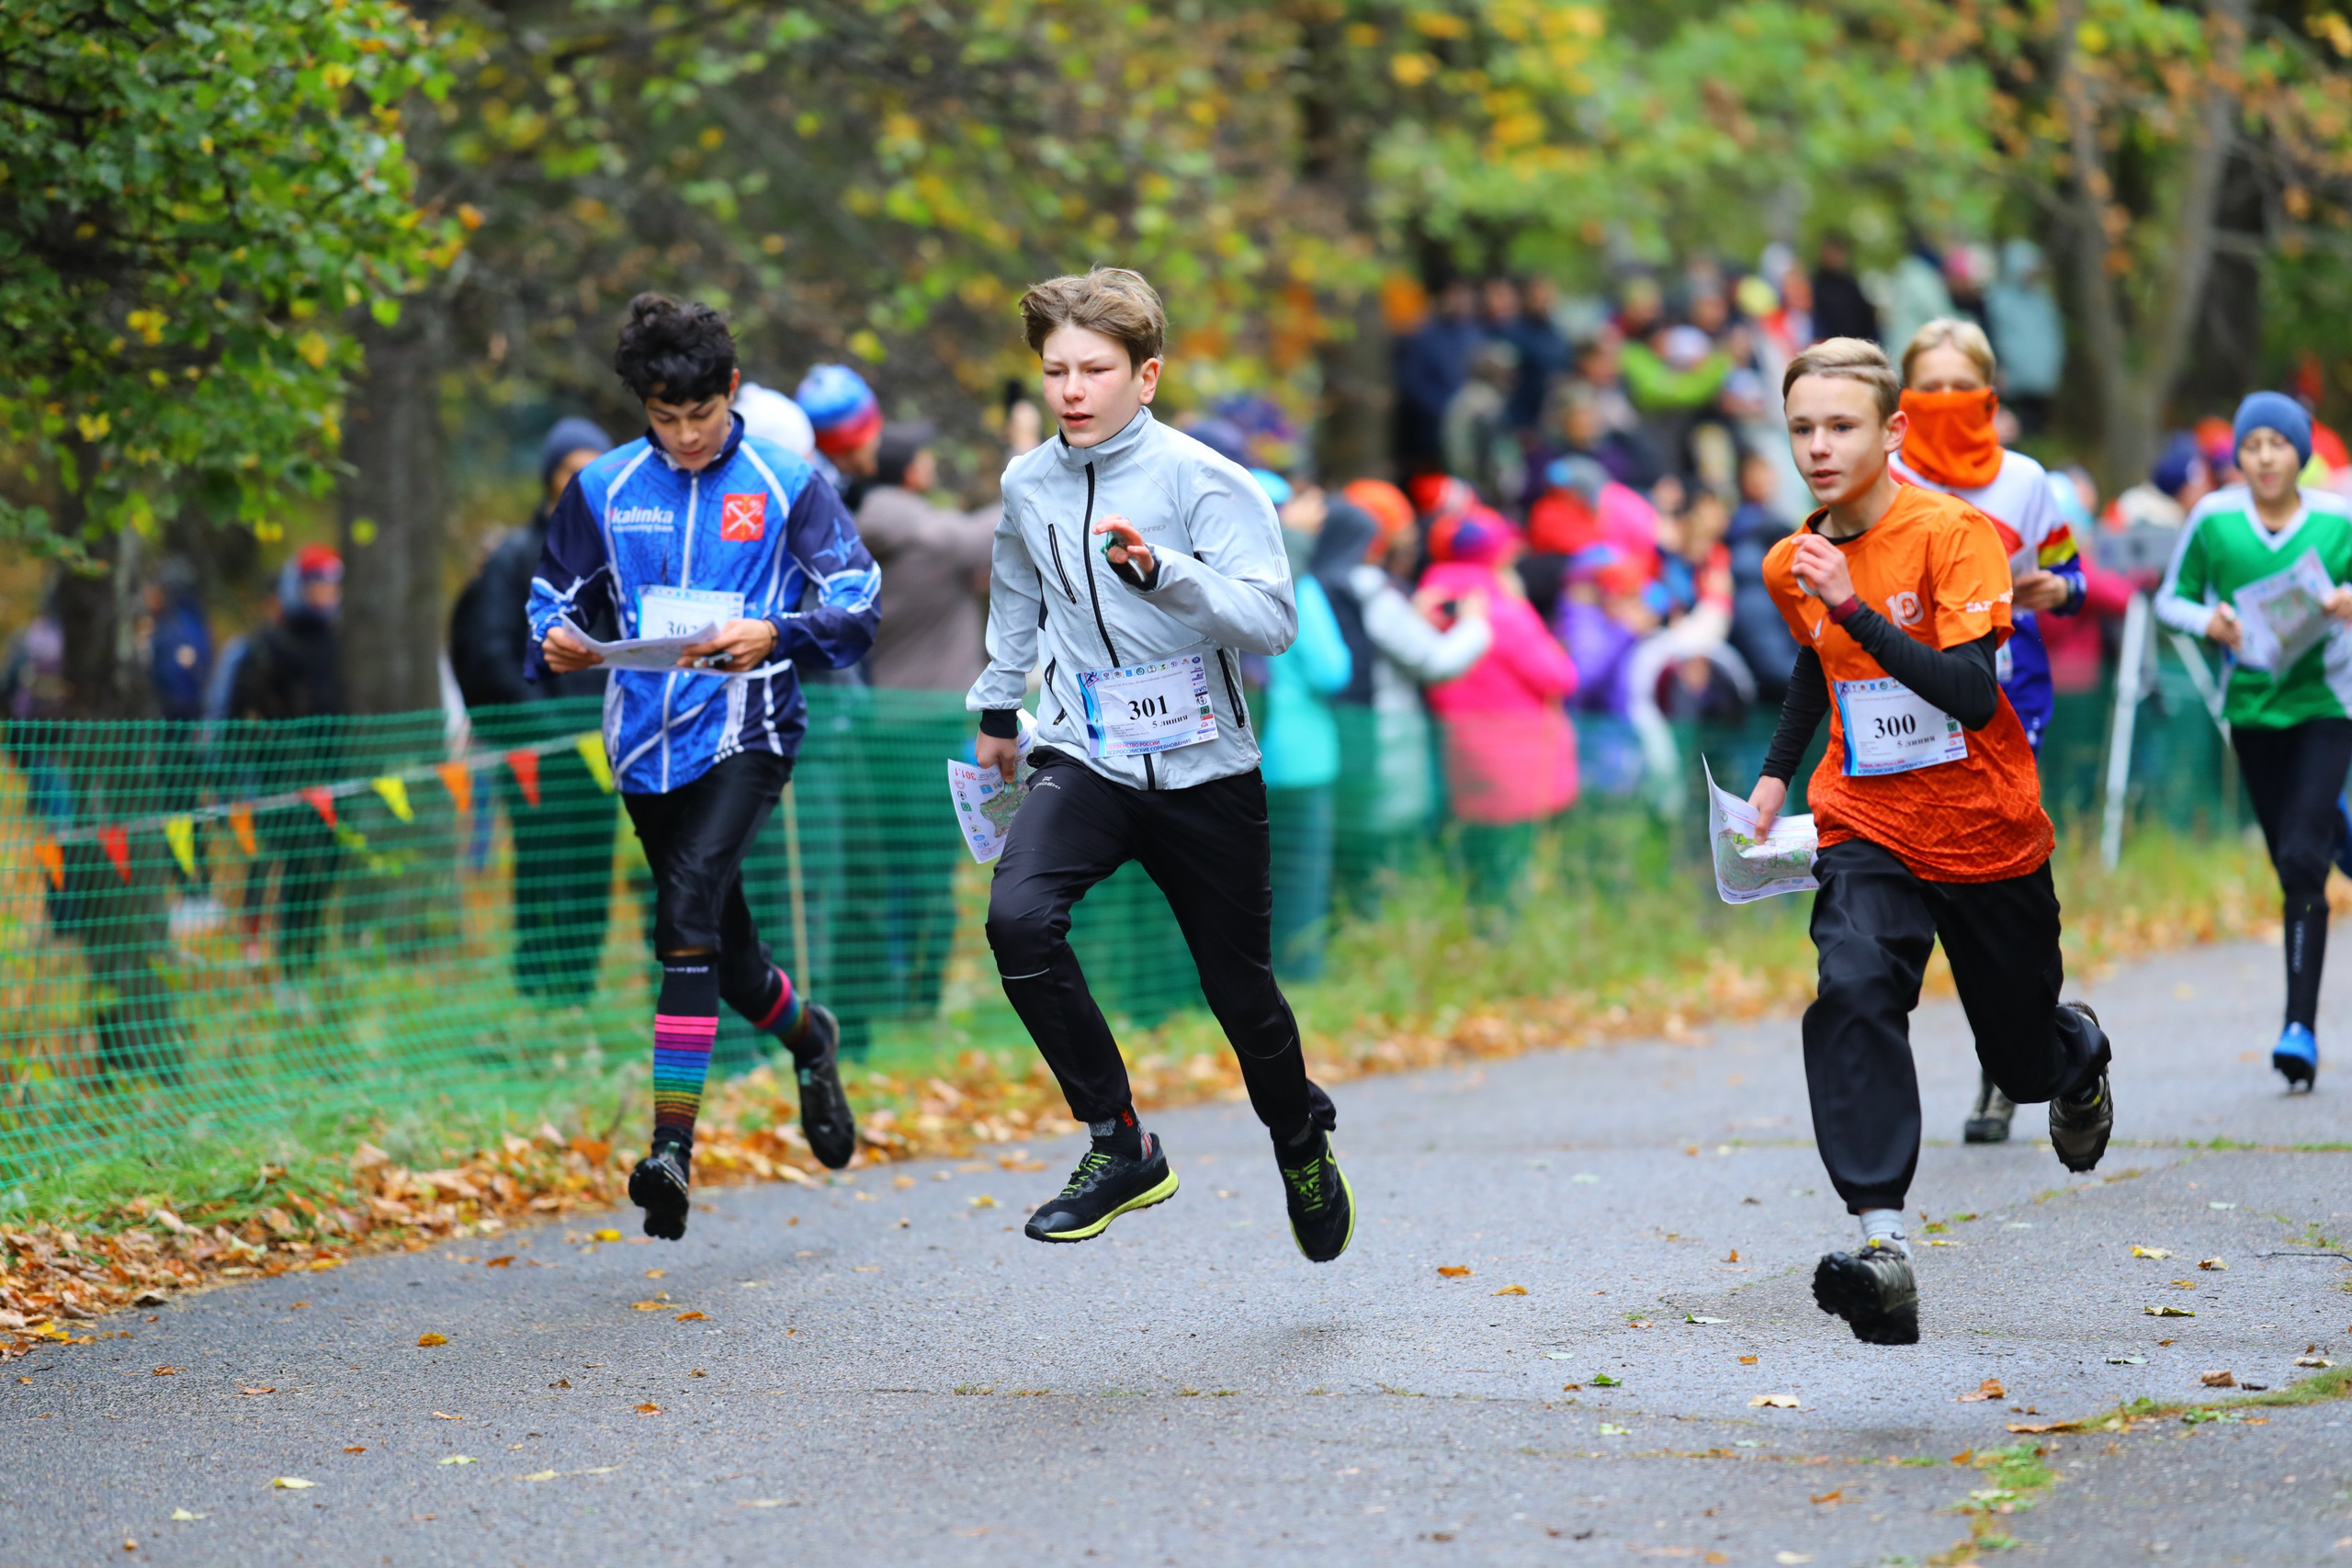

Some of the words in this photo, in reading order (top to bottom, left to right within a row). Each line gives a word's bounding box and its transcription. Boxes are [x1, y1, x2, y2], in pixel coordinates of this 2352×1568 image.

[667, 620, 697, 637] 30
[1127, 694, 1170, 720] 301
[1159, 715, 1188, 727] линия
[1874, 714, 1916, 739] 300
[1139, 739, 1160, 748] РОССИИ
[1150, 738, 1192, 751] СОРЕВНОВАНИЯ
[1897, 740, 1903, 749] 5
[1905, 736, 1936, 748] линия
